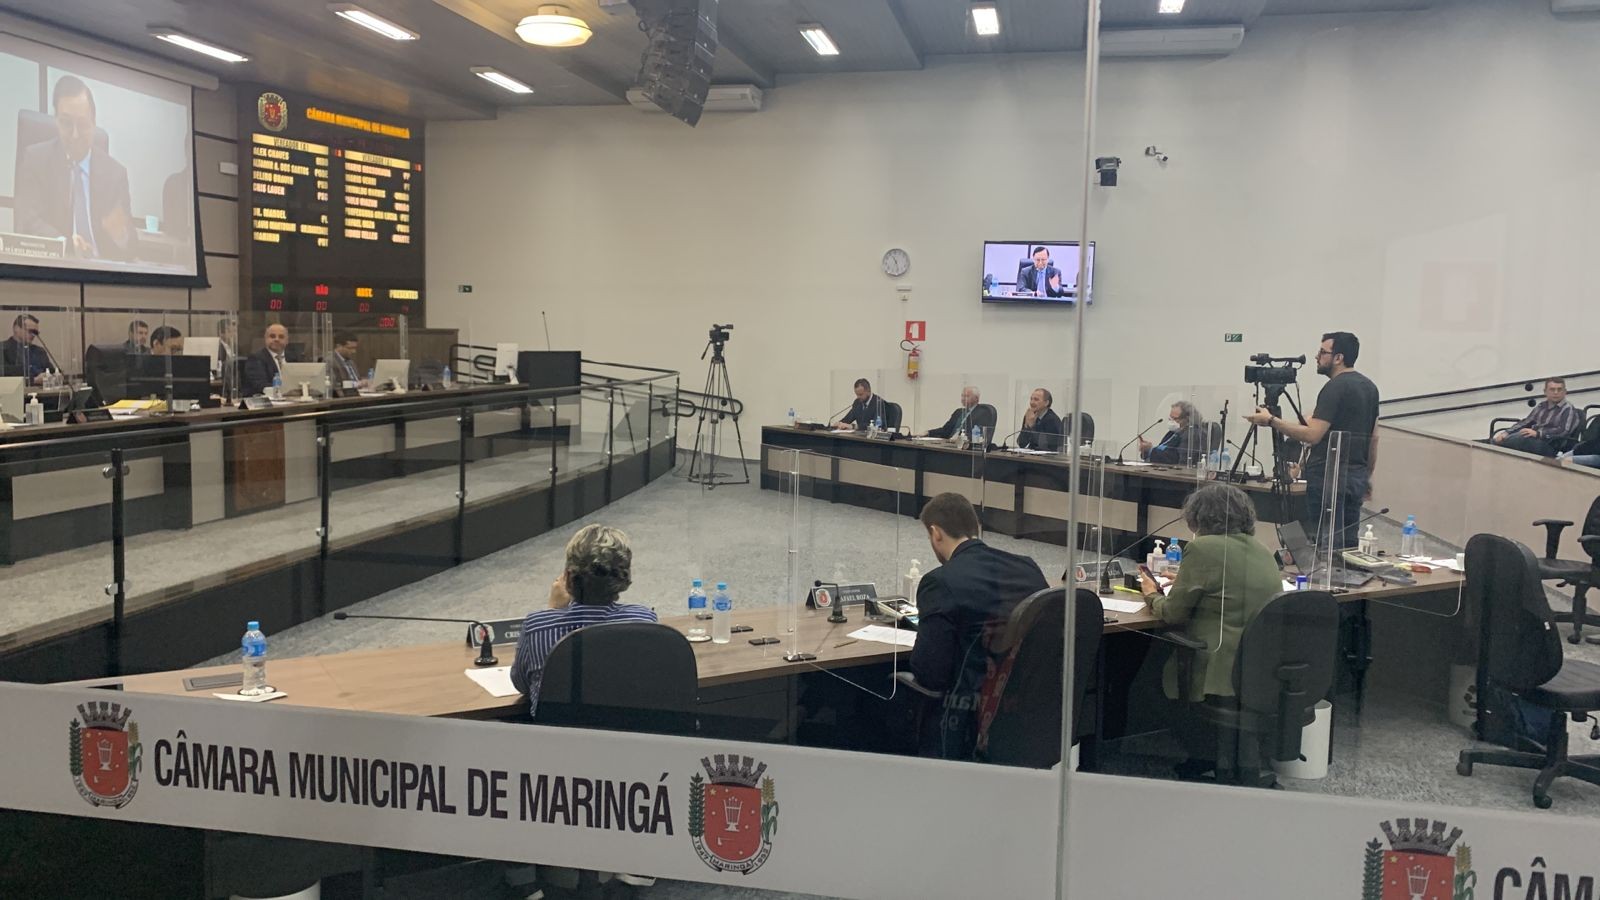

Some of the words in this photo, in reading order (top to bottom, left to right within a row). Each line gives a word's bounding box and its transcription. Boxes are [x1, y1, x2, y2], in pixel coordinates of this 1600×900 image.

[155, 730, 280, 797] CÂMARA
[289, 751, 457, 815] MUNICIPAL
[467, 768, 508, 820] DE
[520, 772, 674, 836] MARINGÁ
